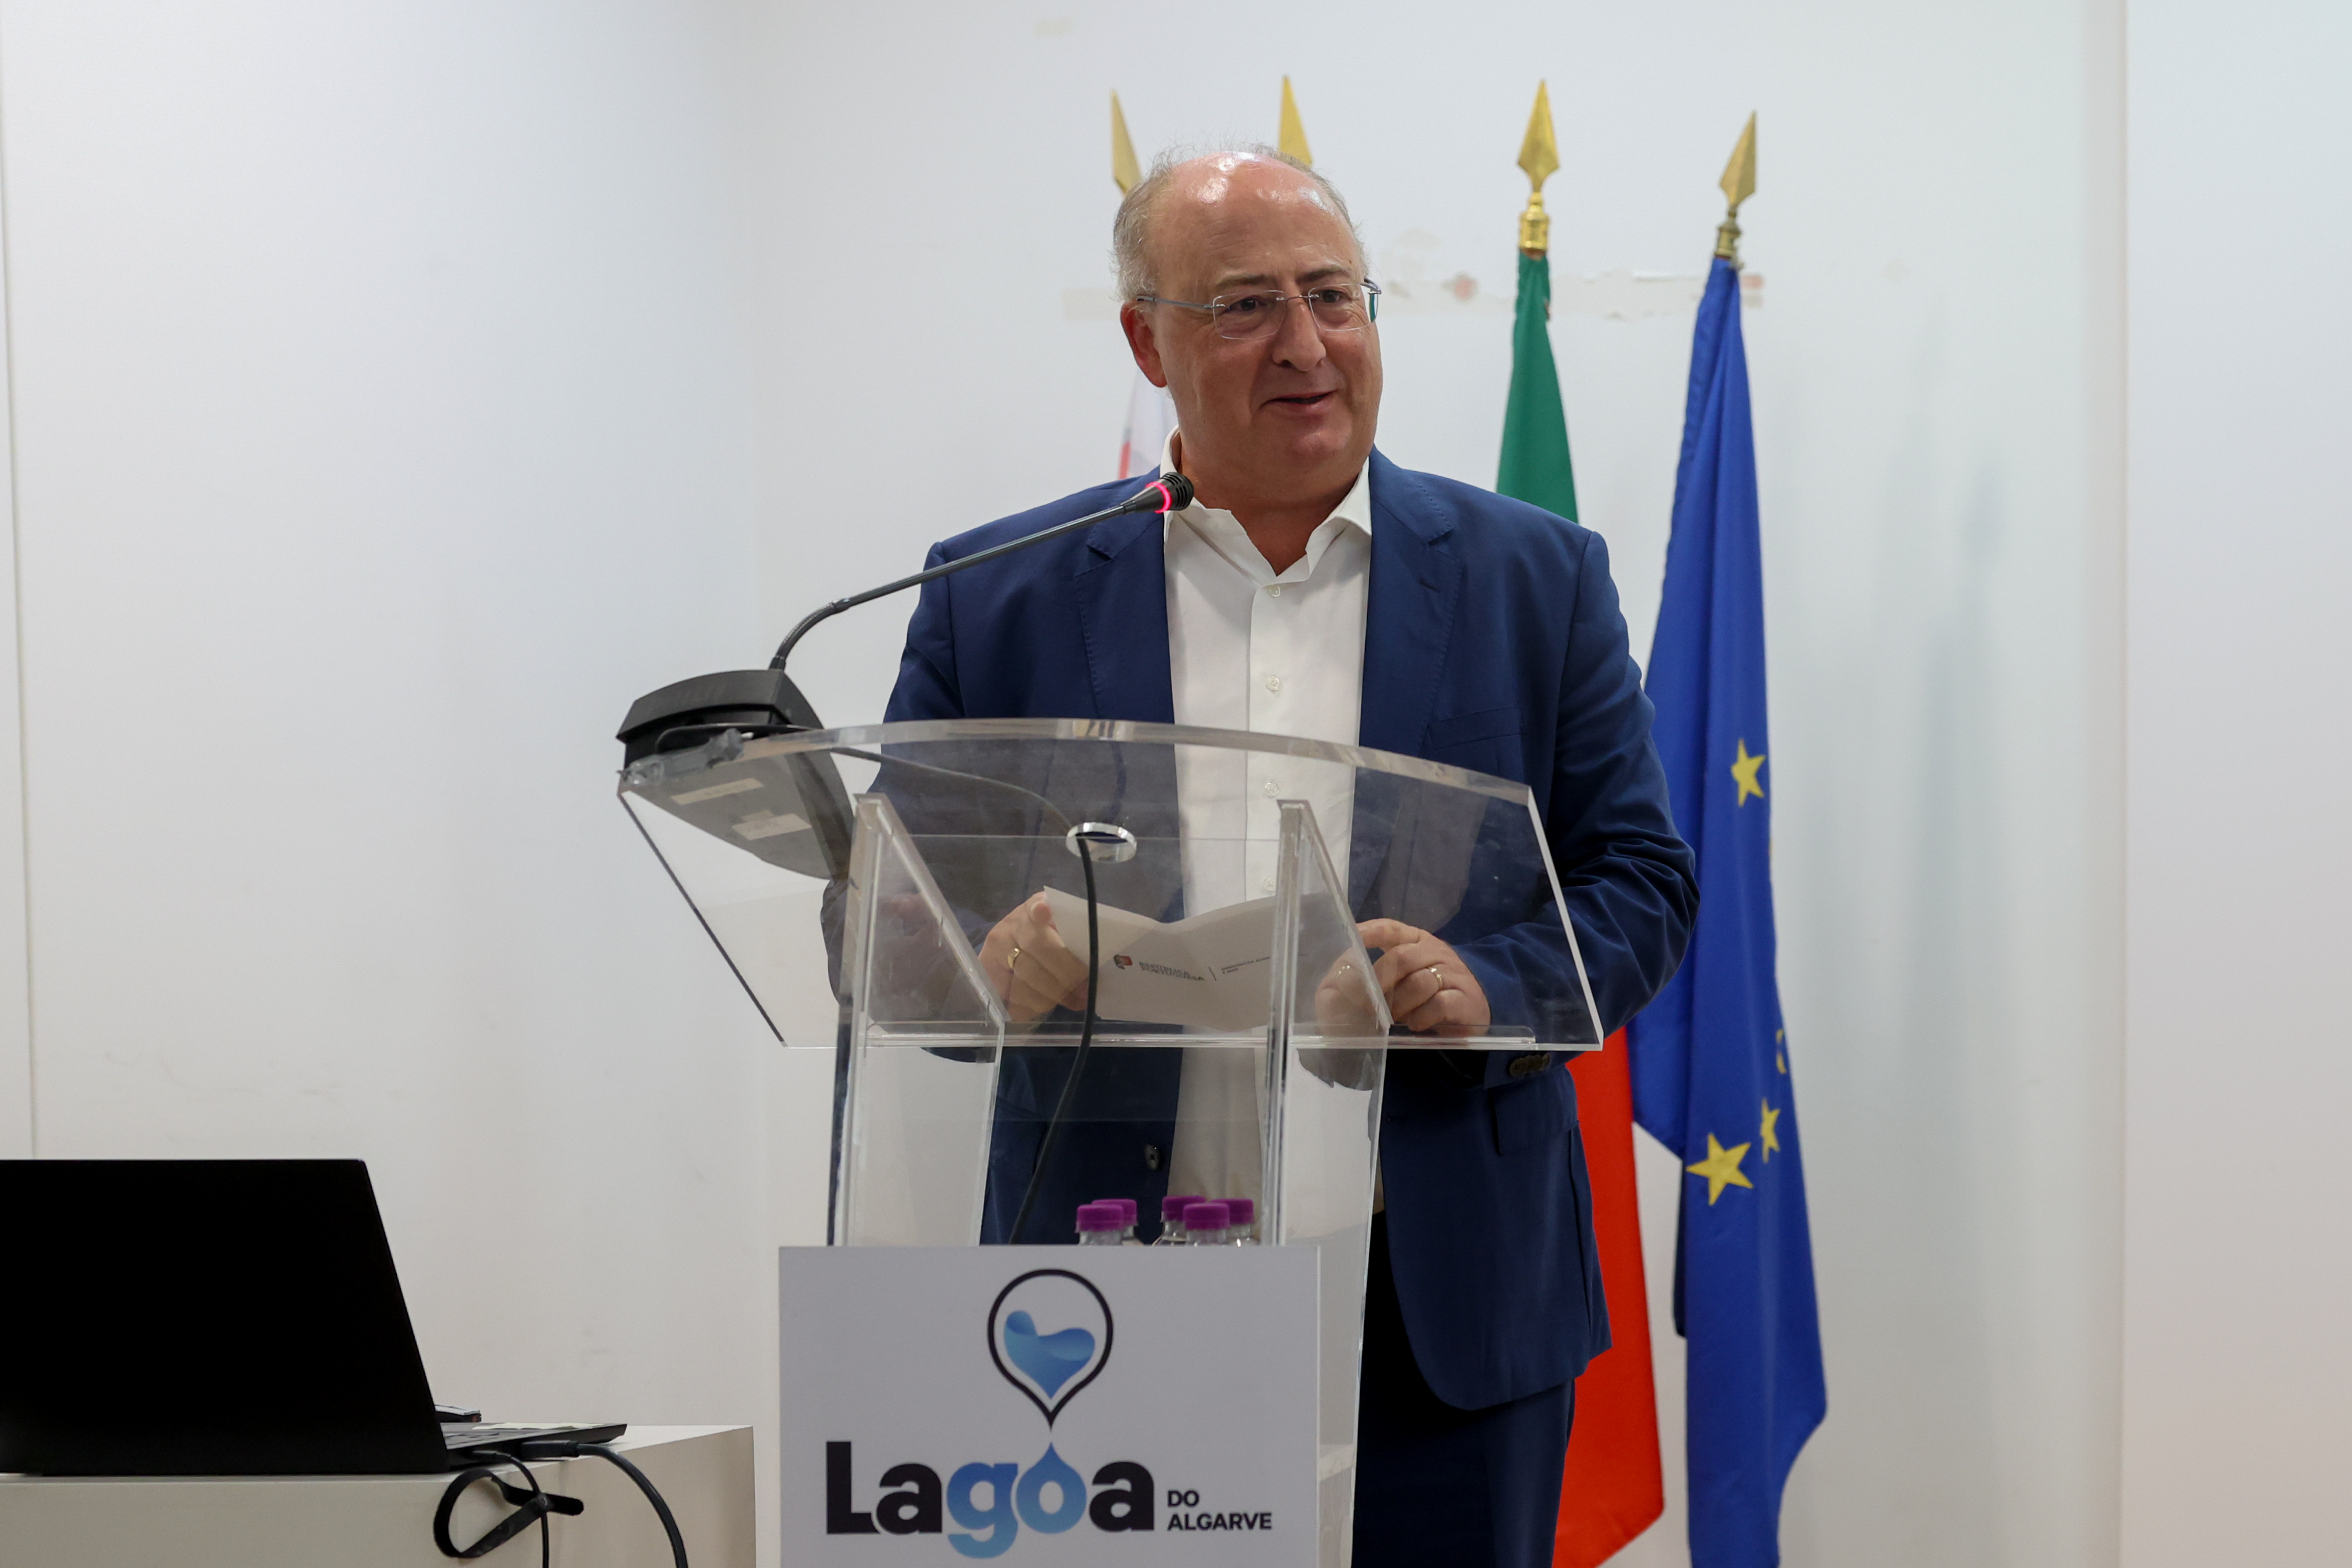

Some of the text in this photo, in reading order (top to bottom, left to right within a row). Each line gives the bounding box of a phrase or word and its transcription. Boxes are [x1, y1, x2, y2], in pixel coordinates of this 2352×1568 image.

[826, 1441, 1154, 1559] Lagoa
[1167, 1489, 1200, 1508] DO
[1167, 1512, 1272, 1531] ALGARVE
